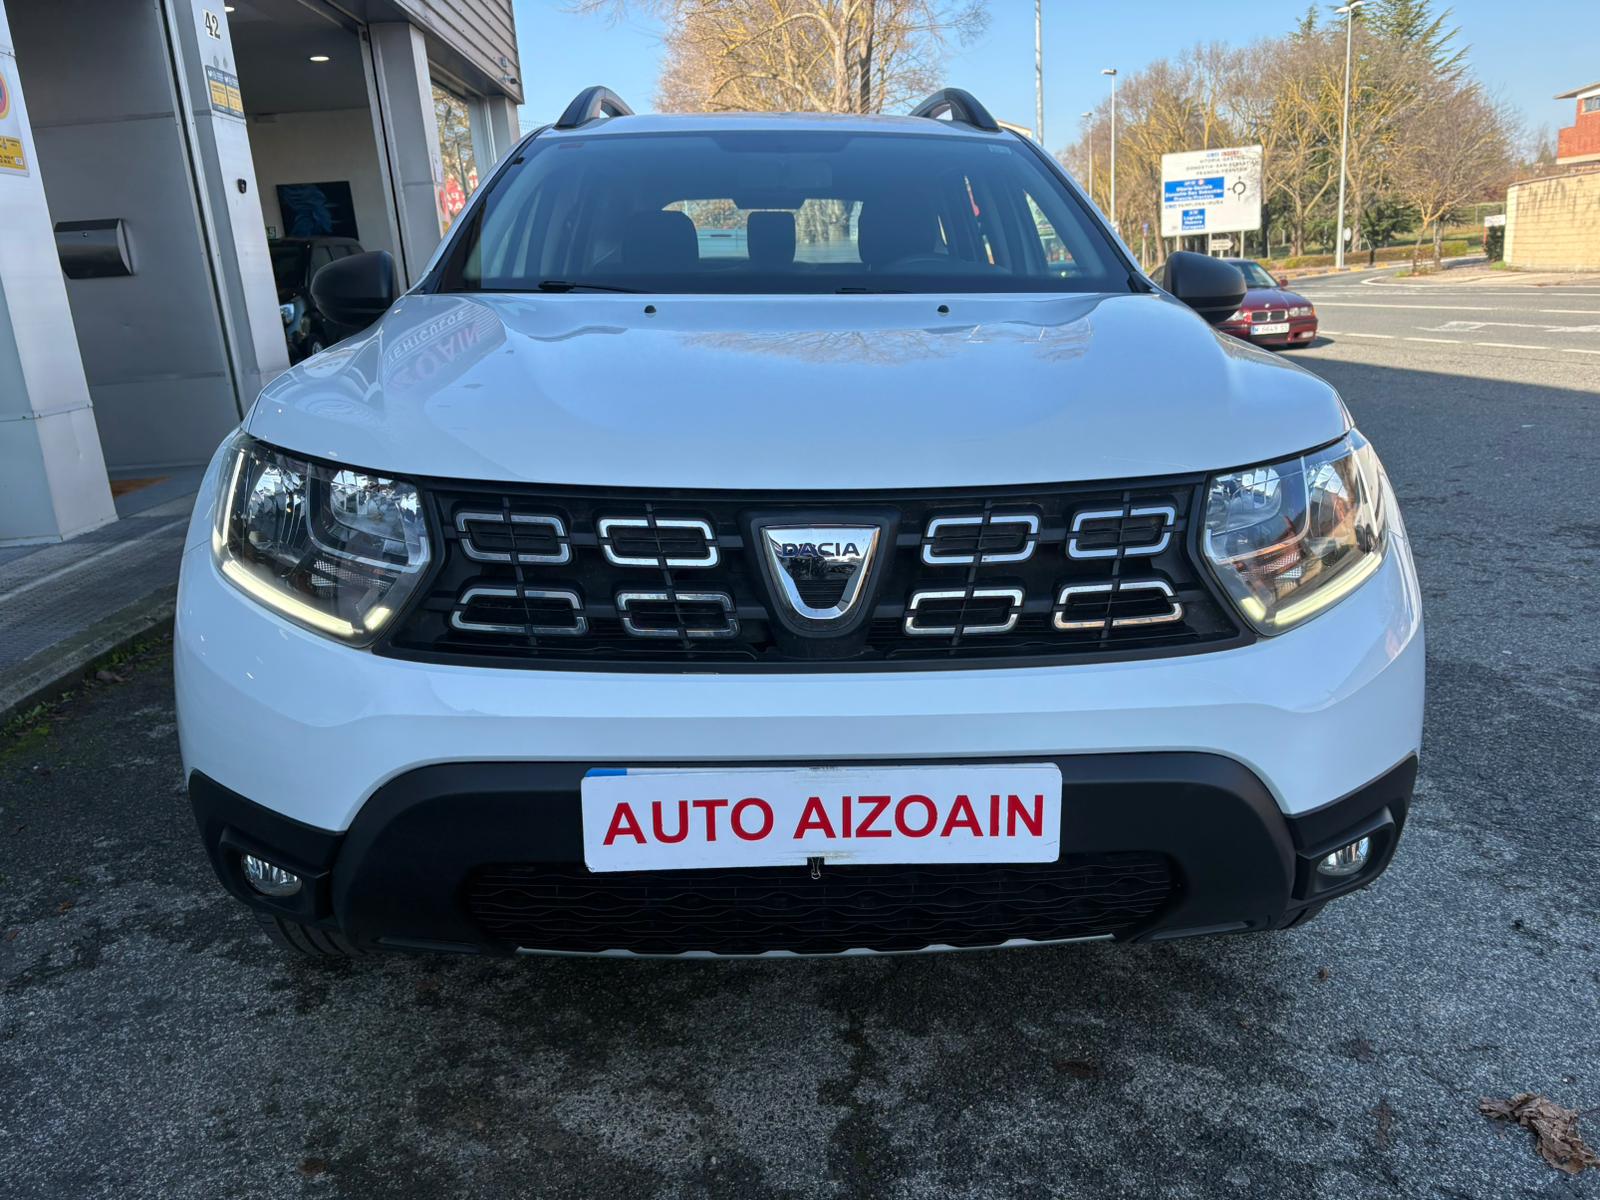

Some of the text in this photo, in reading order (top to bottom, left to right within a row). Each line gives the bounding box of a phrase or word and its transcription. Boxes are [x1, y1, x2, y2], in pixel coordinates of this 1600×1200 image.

[205, 12, 221, 39] 42
[782, 543, 860, 557] DACIA
[603, 795, 1044, 845] AUTO AIZOAIN
